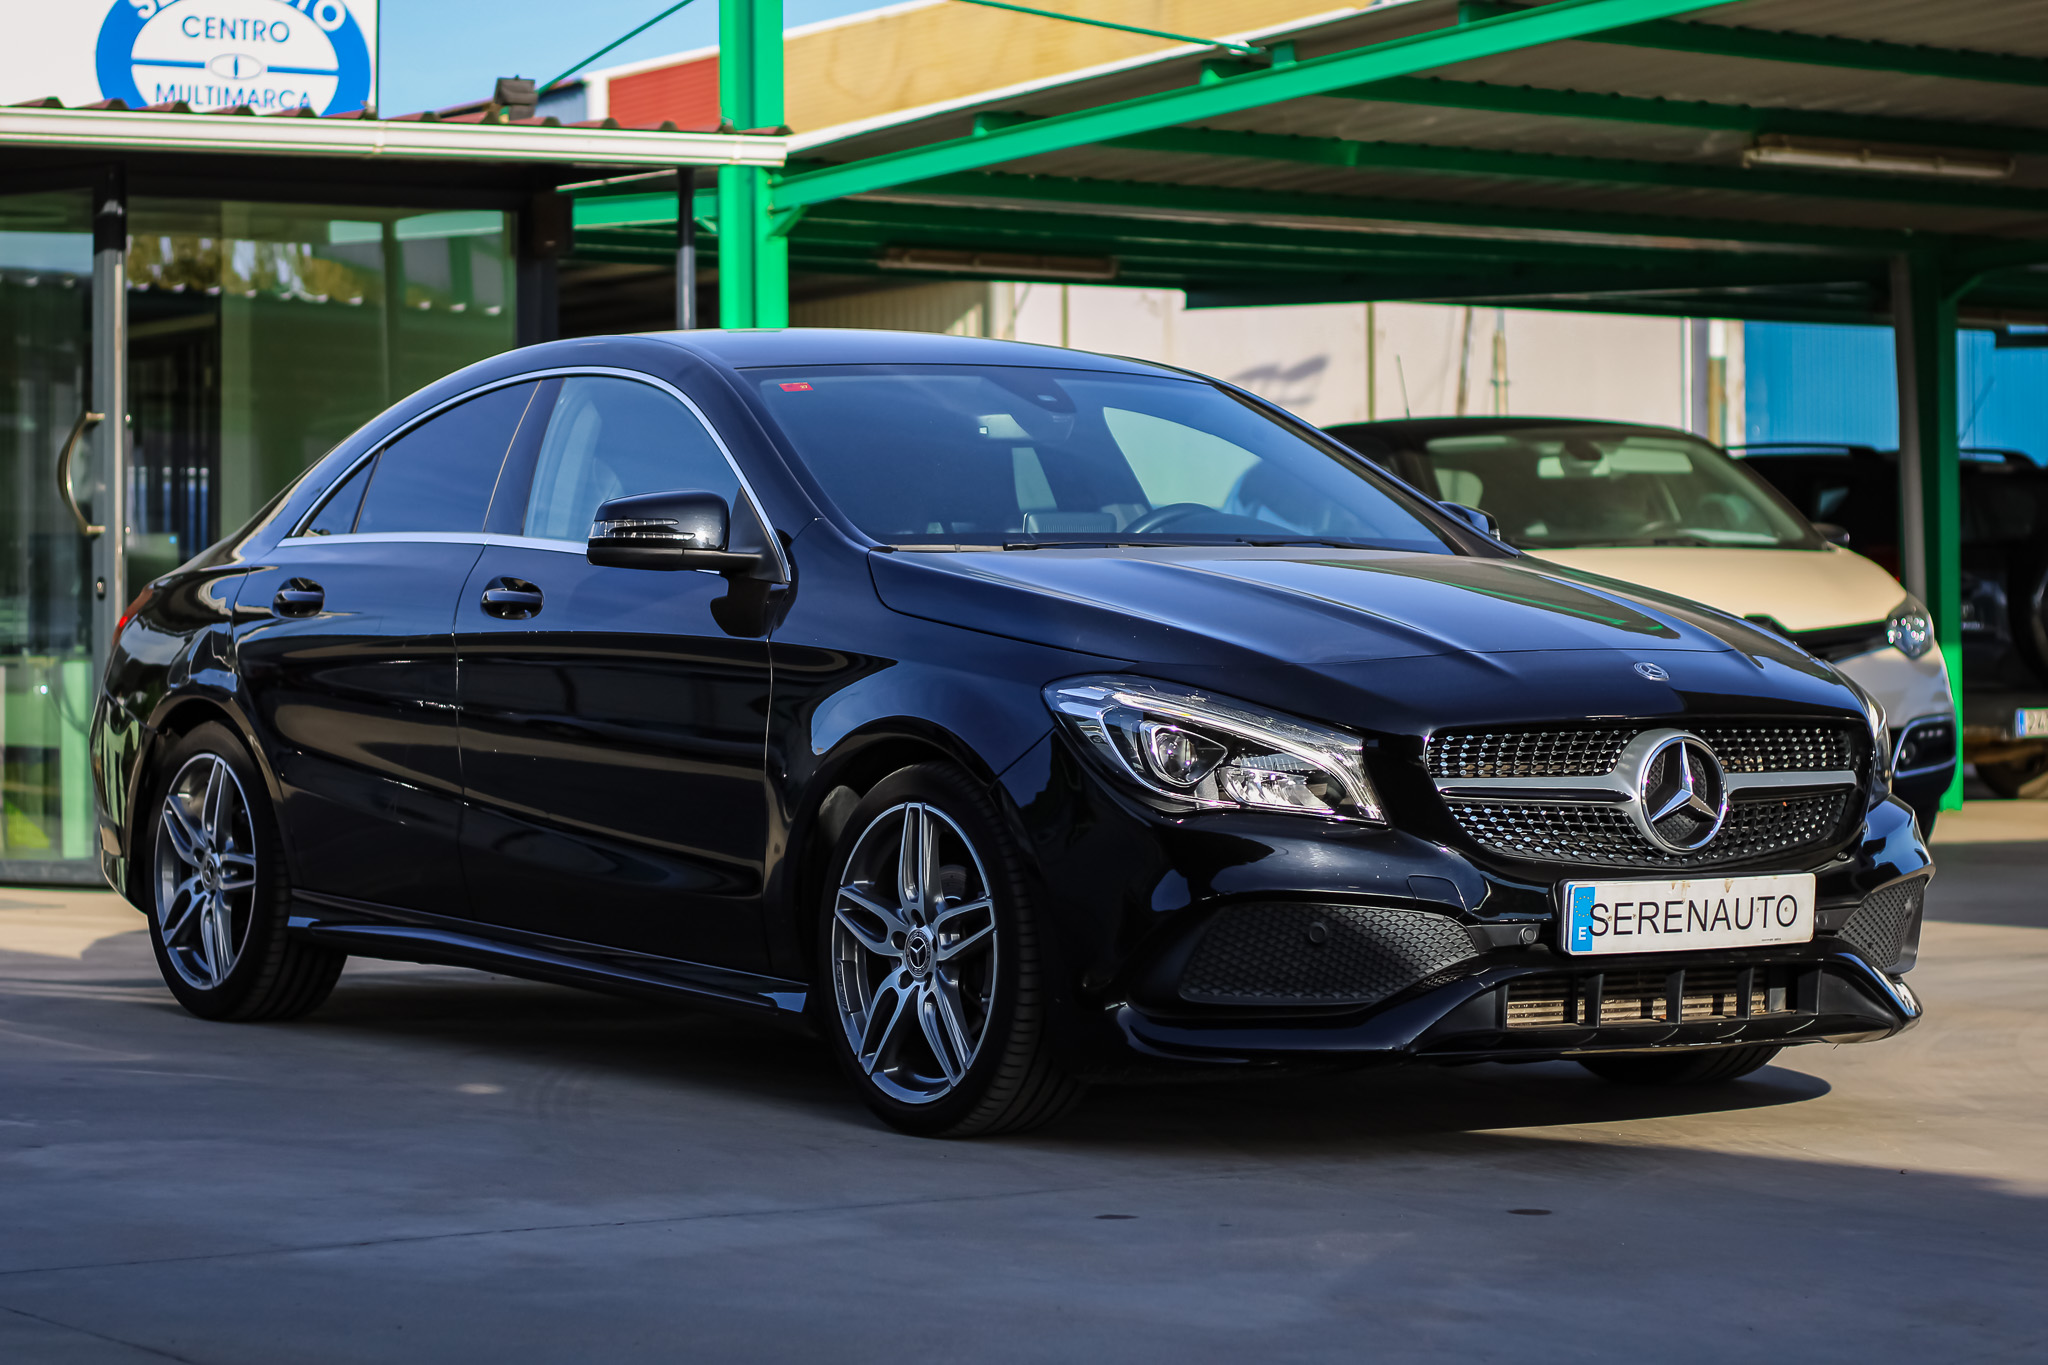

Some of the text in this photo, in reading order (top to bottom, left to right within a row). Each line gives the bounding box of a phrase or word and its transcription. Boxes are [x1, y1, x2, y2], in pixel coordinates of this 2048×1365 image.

[181, 15, 290, 43] CENTRO
[155, 83, 311, 110] MULTIMARCA
[1588, 894, 1798, 937] SERENAUTO
